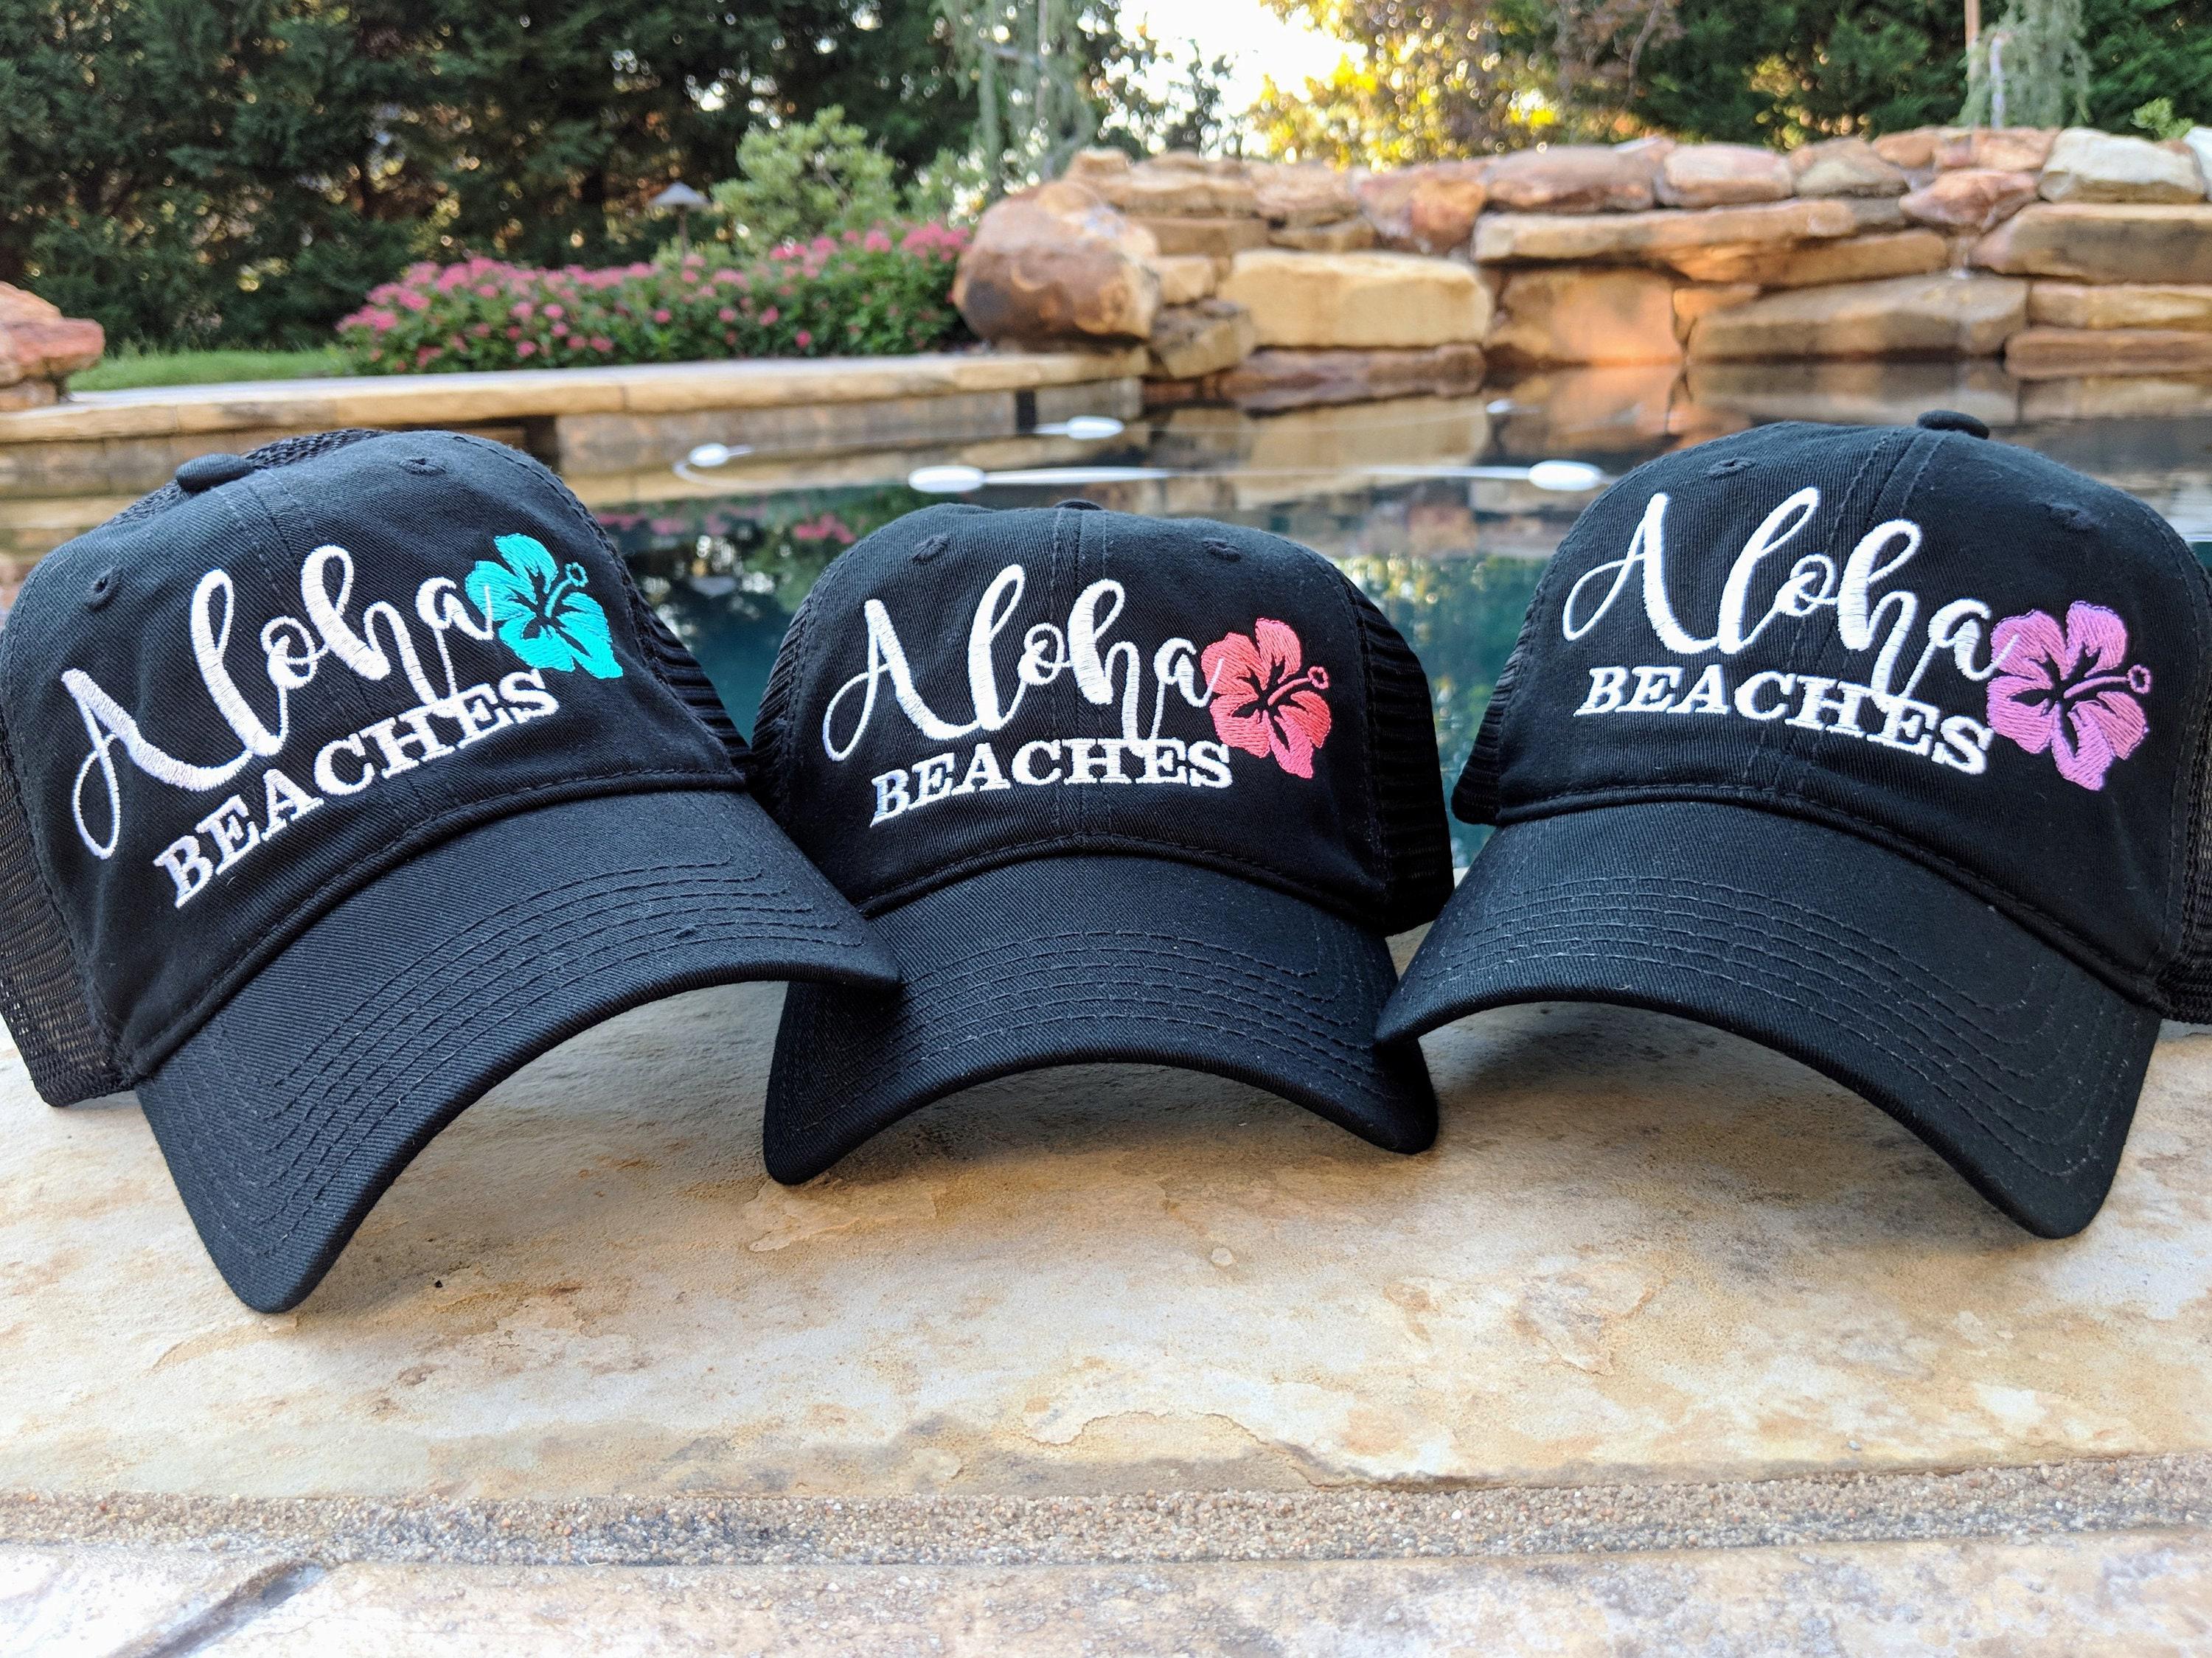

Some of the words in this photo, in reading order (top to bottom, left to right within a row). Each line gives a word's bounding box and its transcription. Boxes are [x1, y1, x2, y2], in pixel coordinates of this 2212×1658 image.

[822, 564, 1225, 762] Aloha
[1562, 487, 2021, 704] Aloha
[60, 544, 494, 860] Aloha
[152, 668, 560, 910] BEACHES
[869, 737, 1234, 828] BEACHES
[1573, 663, 1994, 776] BEACHES
